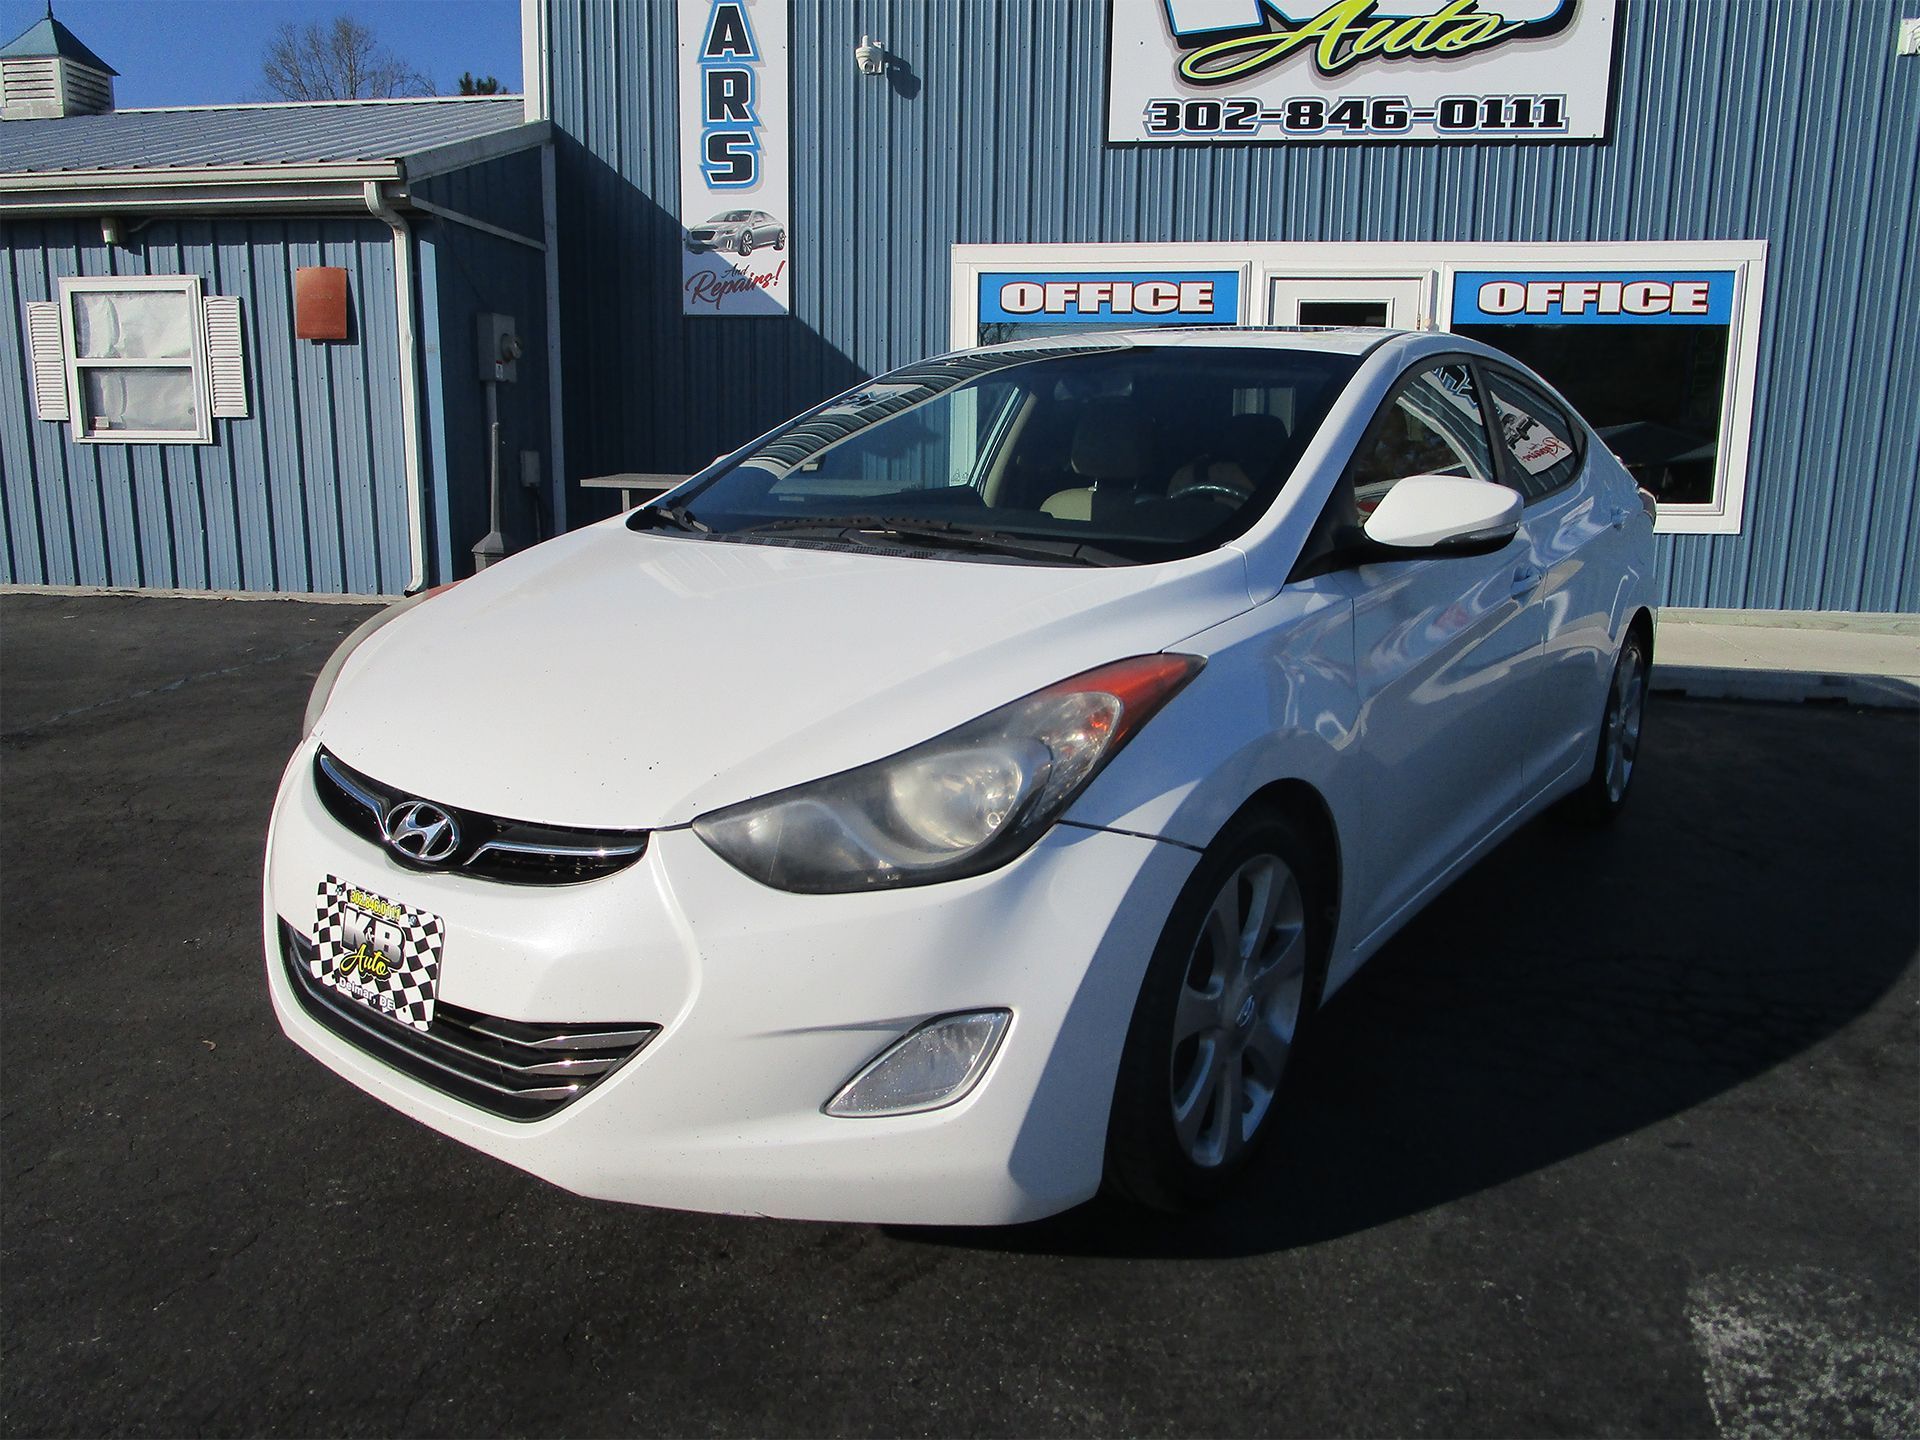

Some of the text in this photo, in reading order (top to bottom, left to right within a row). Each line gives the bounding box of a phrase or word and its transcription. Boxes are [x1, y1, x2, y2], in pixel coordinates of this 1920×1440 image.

[1182, 0, 1525, 79] Auto
[1145, 97, 1567, 132] 302-846-0111
[685, 260, 786, 310] Repairs!
[721, 264, 749, 280] And
[999, 280, 1214, 314] OFFICE
[1477, 280, 1710, 316] OFFICE
[342, 905, 405, 968] K&B
[340, 944, 400, 976] Auto
[379, 994, 396, 1011] DE
